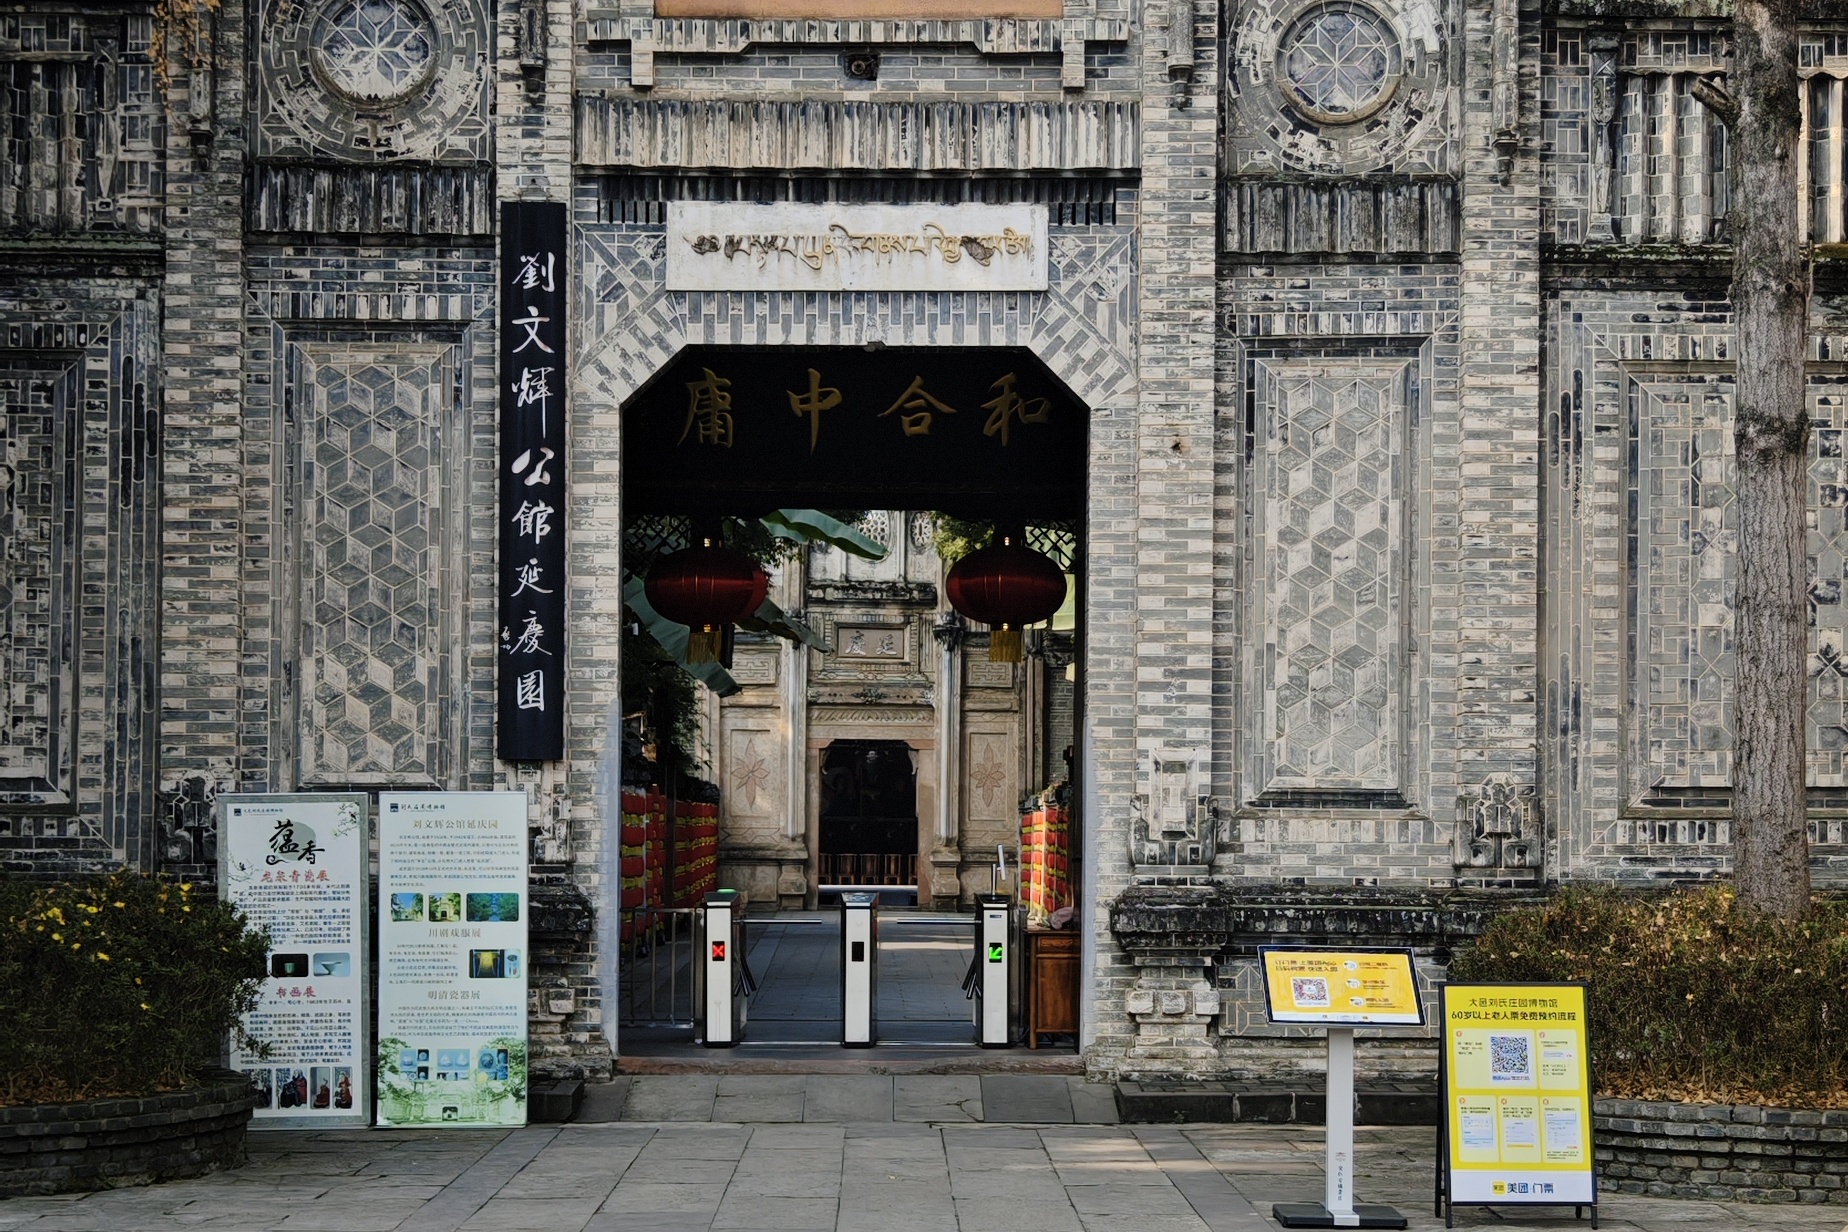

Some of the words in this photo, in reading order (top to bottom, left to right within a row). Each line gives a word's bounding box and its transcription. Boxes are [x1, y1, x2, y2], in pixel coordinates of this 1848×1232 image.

[412, 819, 499, 830] 刘文辉公馆延庆园
[260, 868, 331, 883] 龙泉青瓷展
[428, 927, 482, 938] 川剧戏服展
[275, 985, 317, 999] 书画展
[427, 990, 481, 1000] 明清瓷器展
[1468, 997, 1558, 1009] 大邑刘氏庄园博物馆
[1451, 1010, 1577, 1021] 60岁以上老人票免费预约流程
